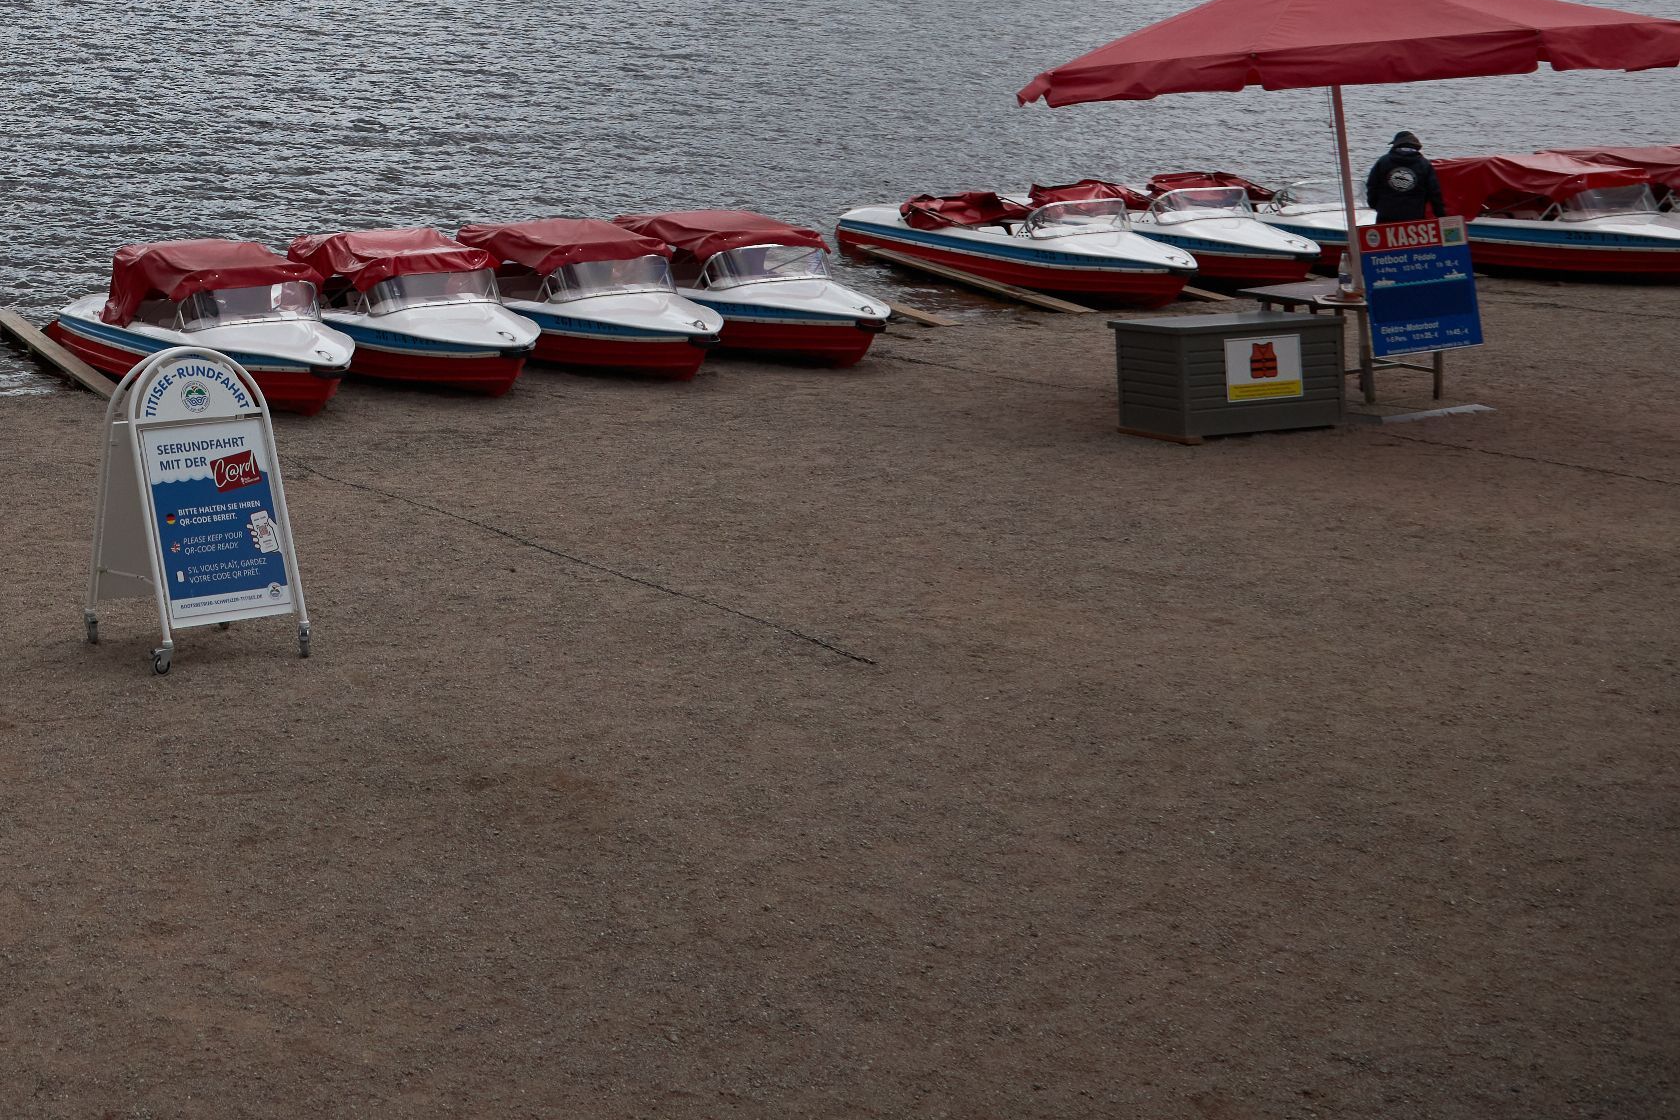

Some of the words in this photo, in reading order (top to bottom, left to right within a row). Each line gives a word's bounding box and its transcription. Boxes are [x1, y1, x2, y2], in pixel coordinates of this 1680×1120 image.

[1385, 223, 1438, 247] KASSE
[146, 365, 250, 417] TITISEE-RUNDFAHRT
[157, 436, 245, 455] SEERUNDFAHRT
[160, 459, 181, 471] MIT
[185, 456, 207, 468] DER
[214, 451, 256, 488] C@rd
[178, 507, 198, 516] BITTE
[199, 504, 226, 513] HALTEN
[227, 502, 238, 510] SIE
[239, 500, 261, 509] IHREN
[180, 516, 212, 526] QR-CODE
[213, 513, 238, 522] BEREIT.
[183, 535, 206, 544] PLEASE
[207, 533, 223, 542] KEEP
[224, 531, 243, 539] YOUR
[184, 544, 216, 555] QR-CODE
[199, 563, 219, 572] VOUS
[240, 557, 268, 567] GARDEZ
[189, 574, 211, 583] VOTRE
[212, 572, 231, 581] CODE
[232, 570, 242, 579] QR
